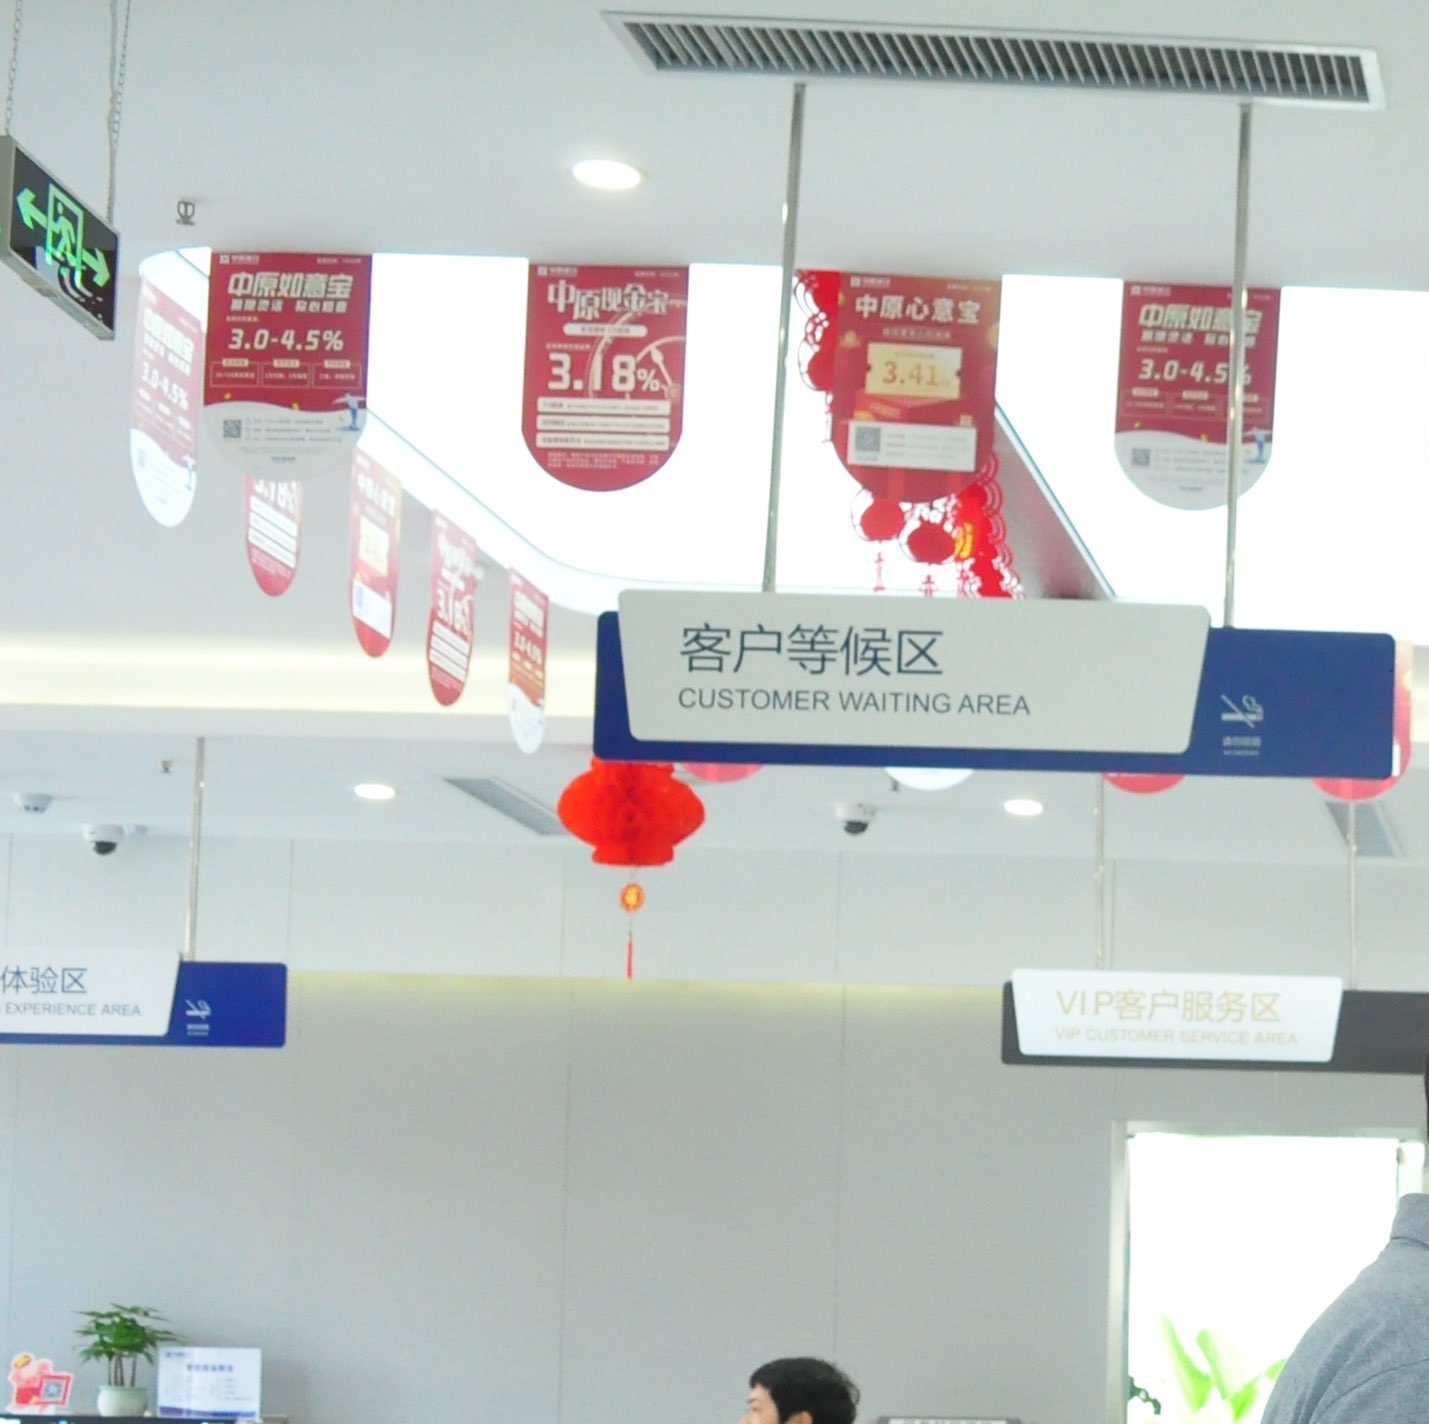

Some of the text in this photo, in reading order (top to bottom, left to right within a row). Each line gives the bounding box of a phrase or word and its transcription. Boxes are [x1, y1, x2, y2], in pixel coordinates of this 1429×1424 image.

[227, 271, 354, 300] 中原如意宝
[547, 279, 669, 321] 中原现金宝
[855, 293, 981, 325] 中原心意宝
[228, 328, 345, 352] 3.0-4.5%
[680, 622, 943, 677] 客户等候区
[678, 686, 1031, 716] CUSTOMER WAITING AREA
[5, 1002, 141, 1016] EXPERIENCE AREA
[1056, 989, 1282, 1024] VIP客户服务区
[1056, 1027, 1299, 1046] VIP CUSTOMER SERVICE AREA
